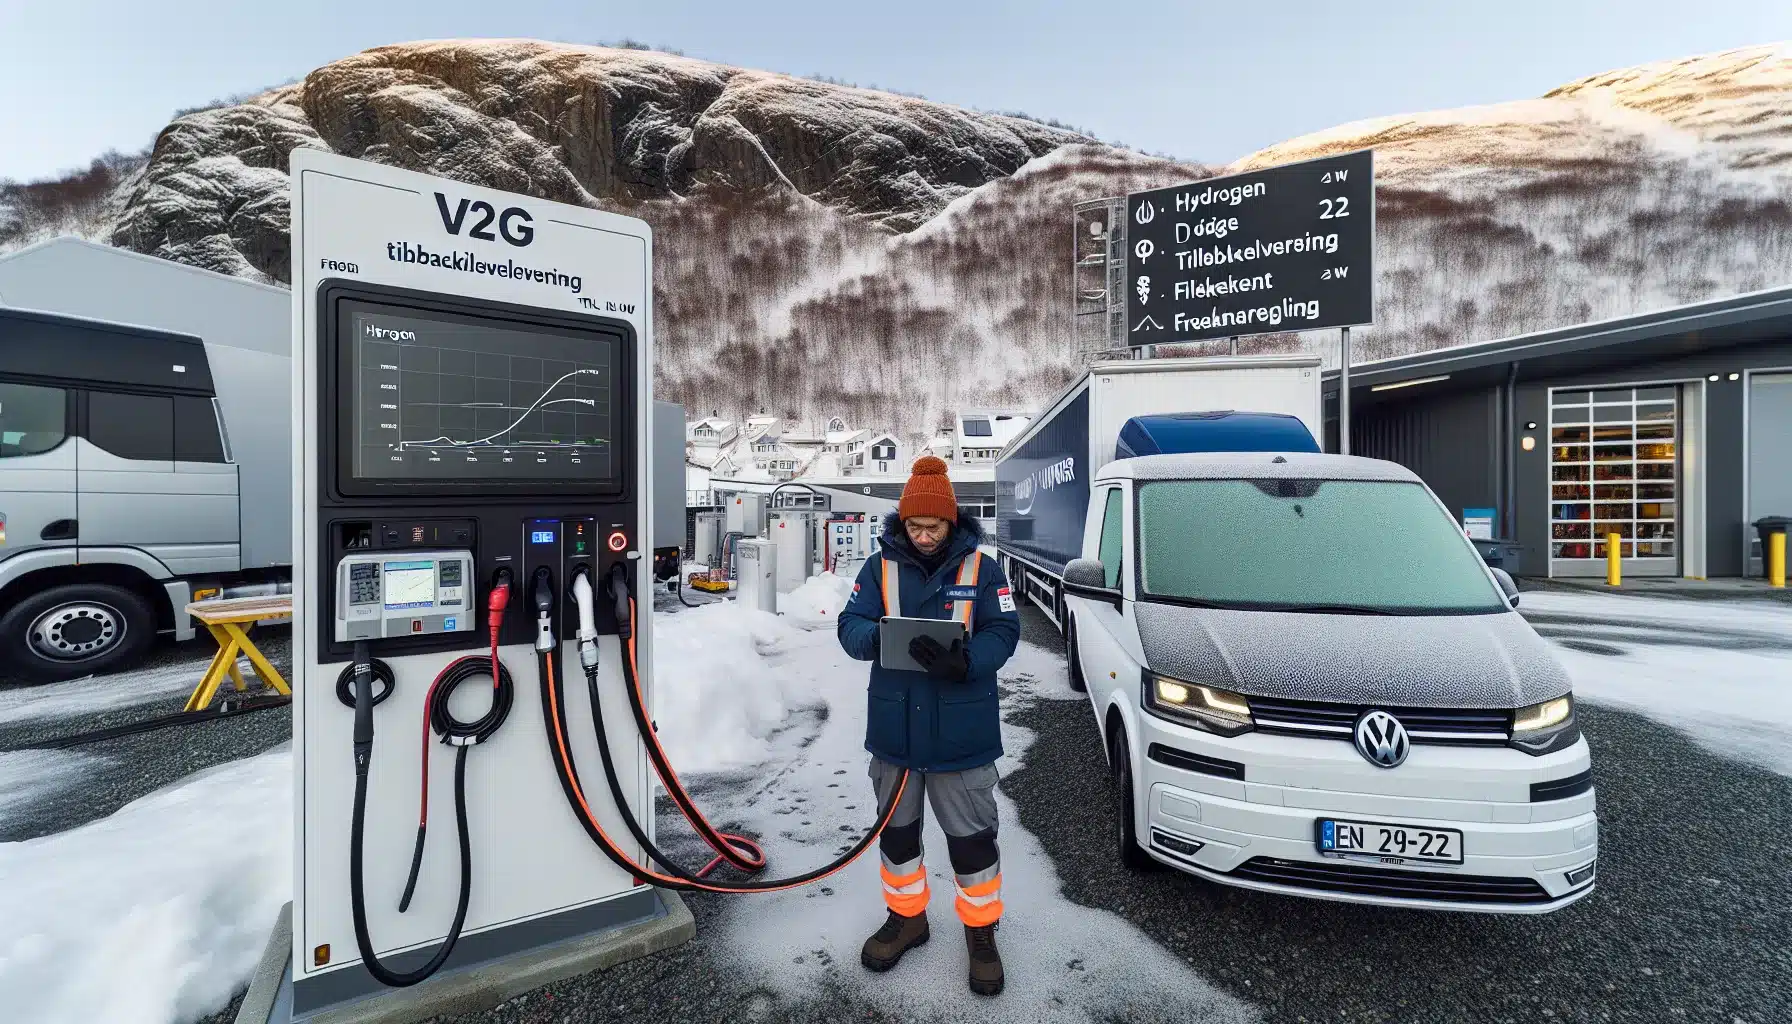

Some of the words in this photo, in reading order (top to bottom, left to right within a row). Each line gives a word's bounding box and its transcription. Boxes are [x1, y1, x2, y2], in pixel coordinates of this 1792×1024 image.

[1176, 182, 1266, 212] Hydrogen
[1319, 196, 1350, 220] 22
[434, 192, 534, 247] V2G
[1336, 824, 1364, 849] EN
[1378, 828, 1452, 858] 29-22
